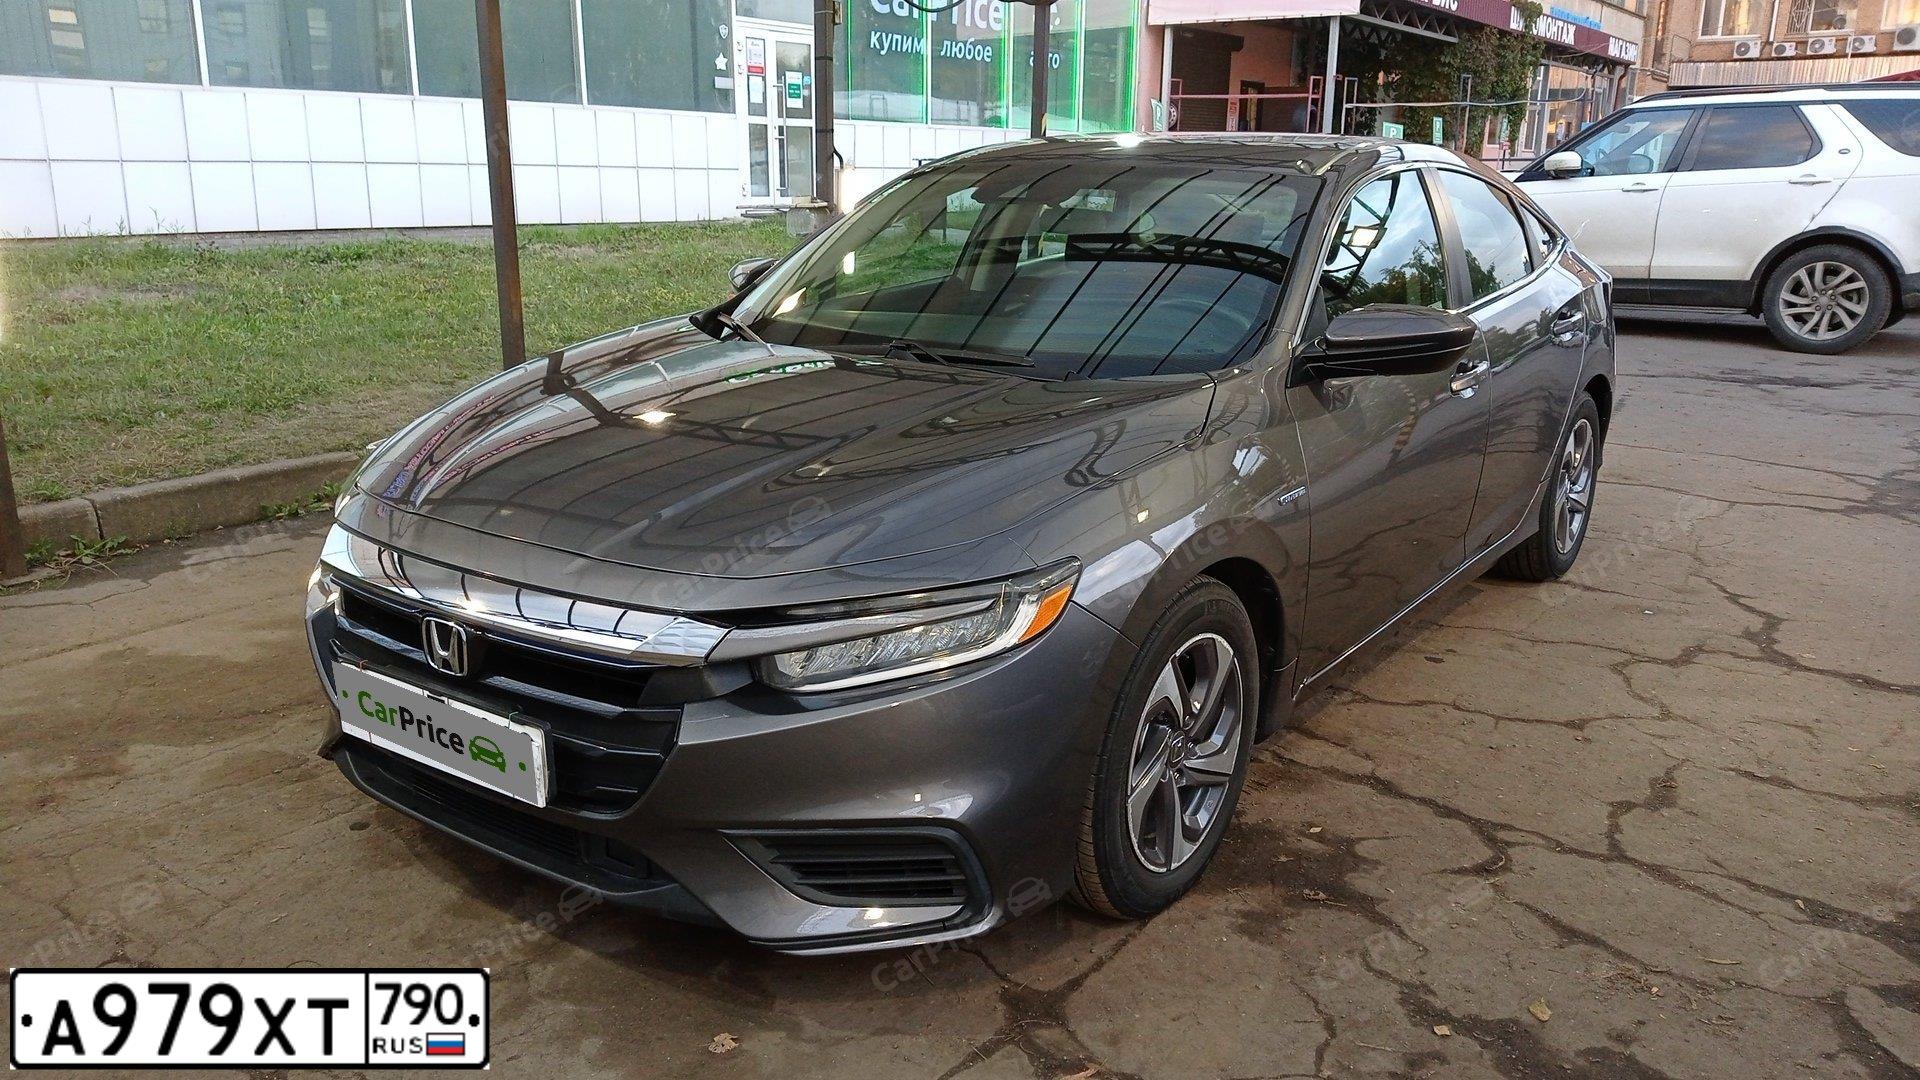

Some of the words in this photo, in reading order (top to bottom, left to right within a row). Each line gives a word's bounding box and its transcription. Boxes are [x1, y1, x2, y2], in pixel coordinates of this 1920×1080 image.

[1509, 6, 1576, 45] ШОМОНТАЖ
[870, 30, 925, 55] купим
[940, 37, 993, 62] любое
[1029, 50, 1060, 69] то
